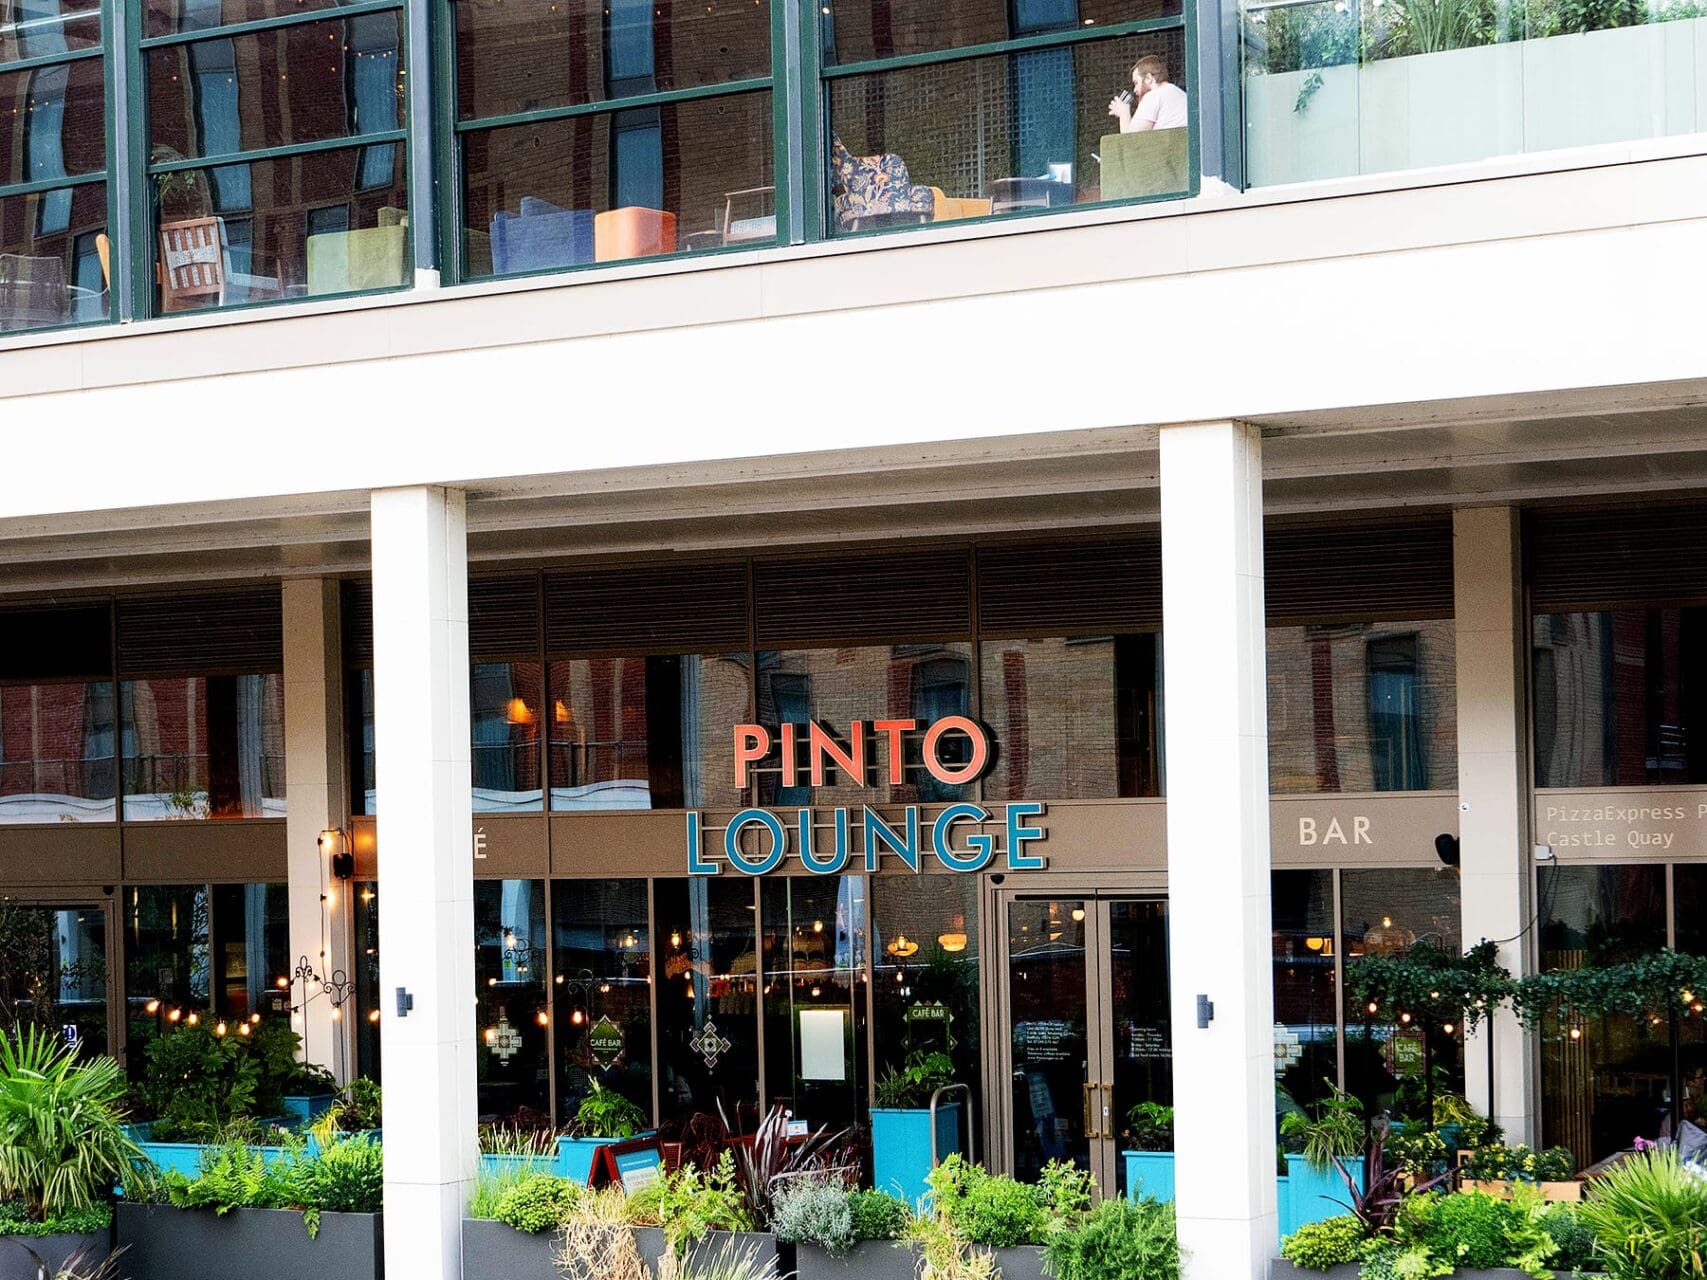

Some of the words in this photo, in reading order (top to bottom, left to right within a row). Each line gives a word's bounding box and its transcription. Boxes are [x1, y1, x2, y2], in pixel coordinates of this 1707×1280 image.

[733, 716, 990, 788] PINTO
[1546, 805, 1686, 825] PizzaExpress
[687, 803, 1047, 875] LOUNGE
[1298, 816, 1374, 846] BAR
[1546, 829, 1617, 847] Castle
[1627, 830, 1675, 849] Quay
[912, 1007, 930, 1018] CAFÉ
[930, 1009, 945, 1018] BAR
[590, 1038, 607, 1047] CAFÉ
[608, 1039, 622, 1047] BAR
